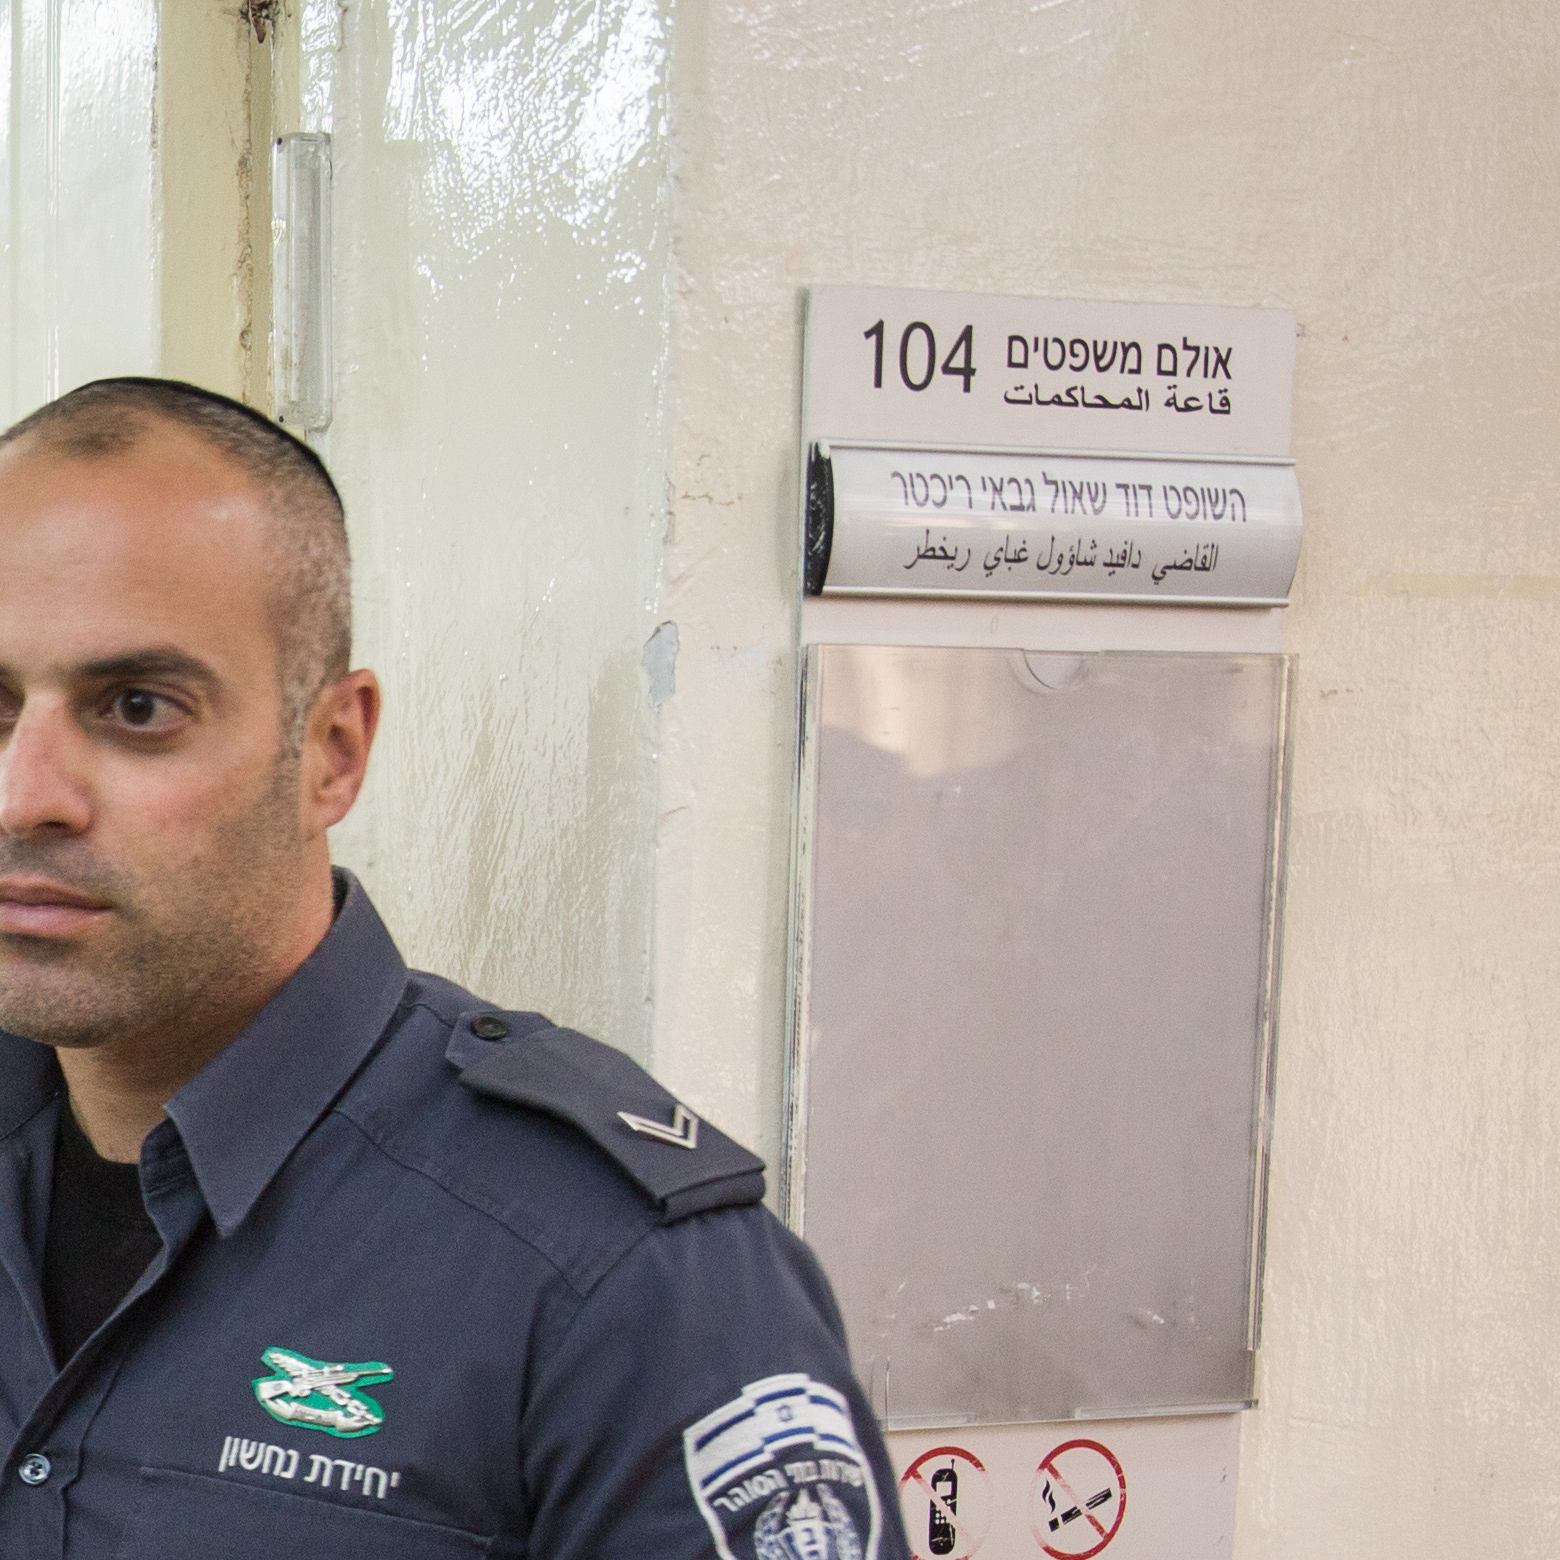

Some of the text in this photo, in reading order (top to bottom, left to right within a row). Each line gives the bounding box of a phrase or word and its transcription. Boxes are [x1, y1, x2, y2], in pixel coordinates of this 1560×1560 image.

[863, 318, 1233, 394] אולם משפטים 104
[1003, 382, 1232, 416] قاعة المحاكمات
[890, 470, 1248, 523] השופט דוד שאול גבאי ריכטר
[902, 528, 1220, 586] القاضي دافيد شاؤول غباي ريخطر
[217, 1435, 402, 1499] יחידת נחשון
